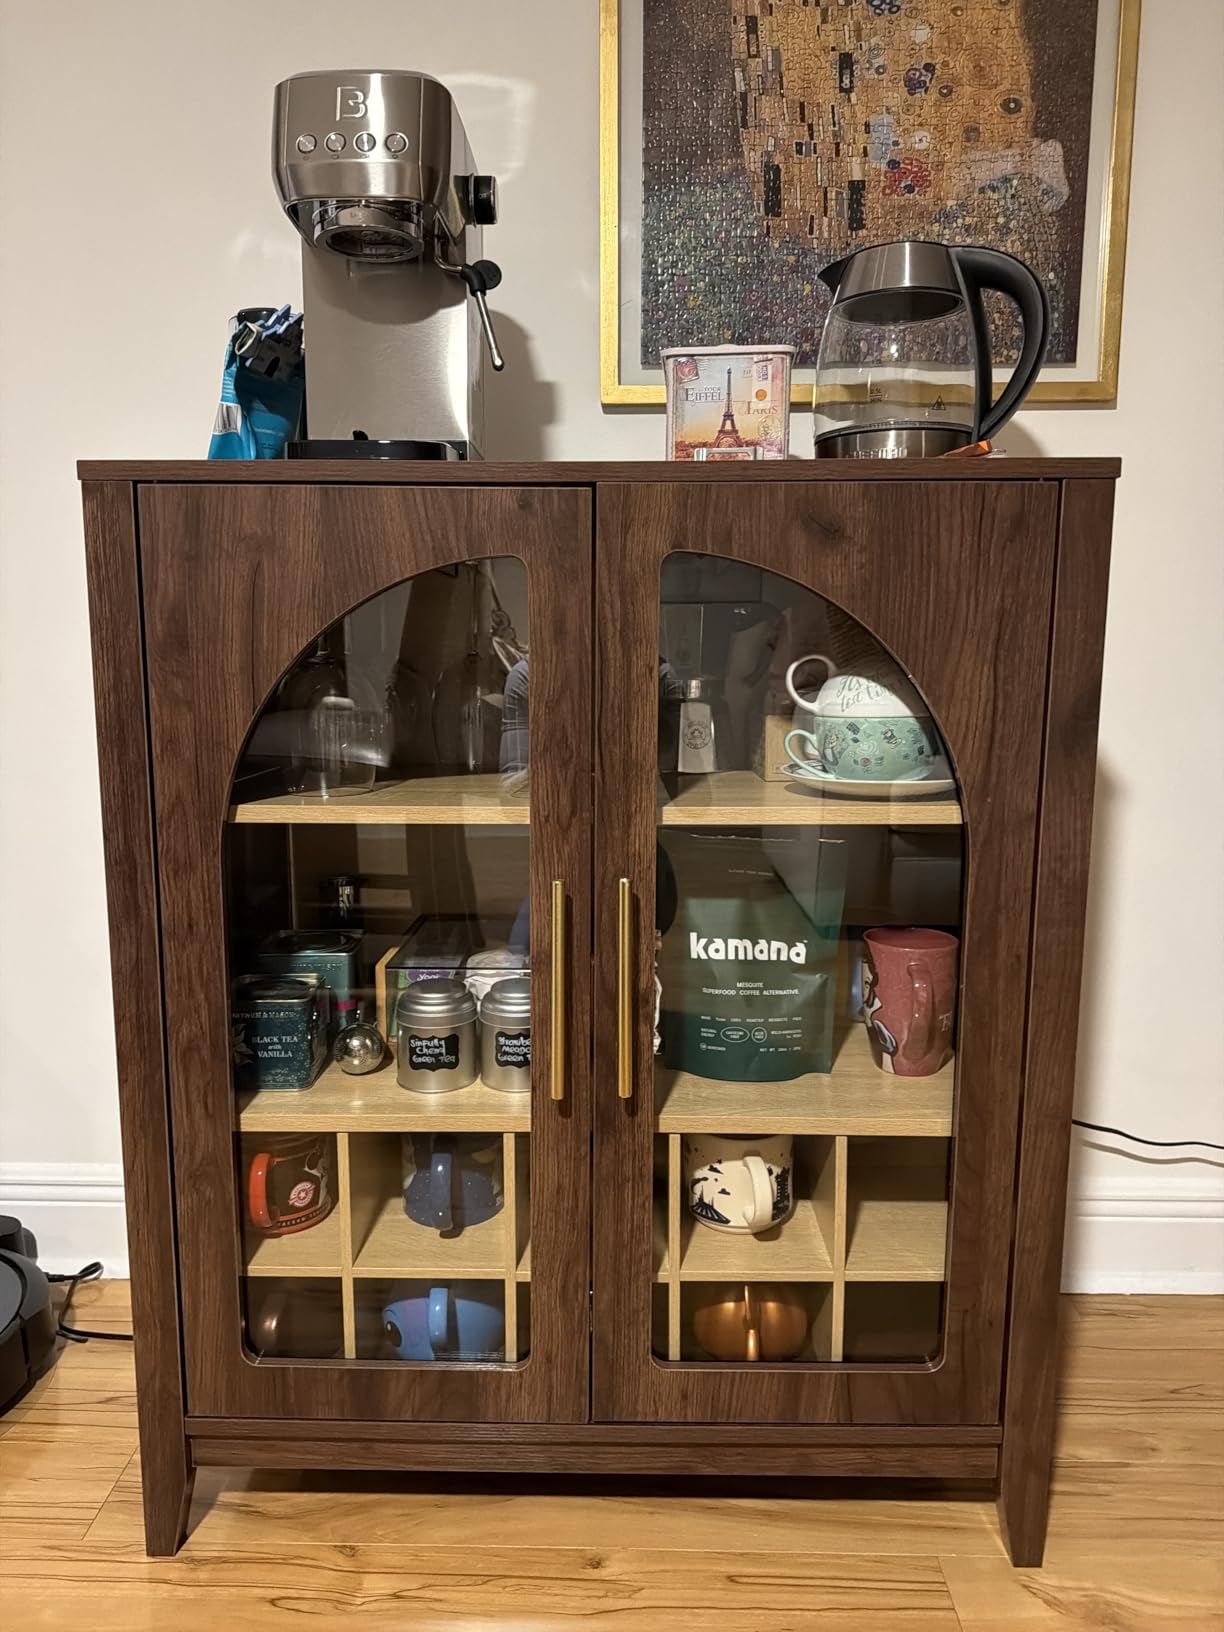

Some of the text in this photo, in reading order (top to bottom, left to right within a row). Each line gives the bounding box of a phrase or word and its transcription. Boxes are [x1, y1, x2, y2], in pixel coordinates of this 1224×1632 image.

[685, 387, 725, 401] EIFFEL
[689, 932, 808, 964] kamana
[702, 987, 737, 995] SUPERFOOD
[763, 988, 800, 996] ALTERNATIVE
[257, 1050, 293, 1058] VANILLA
